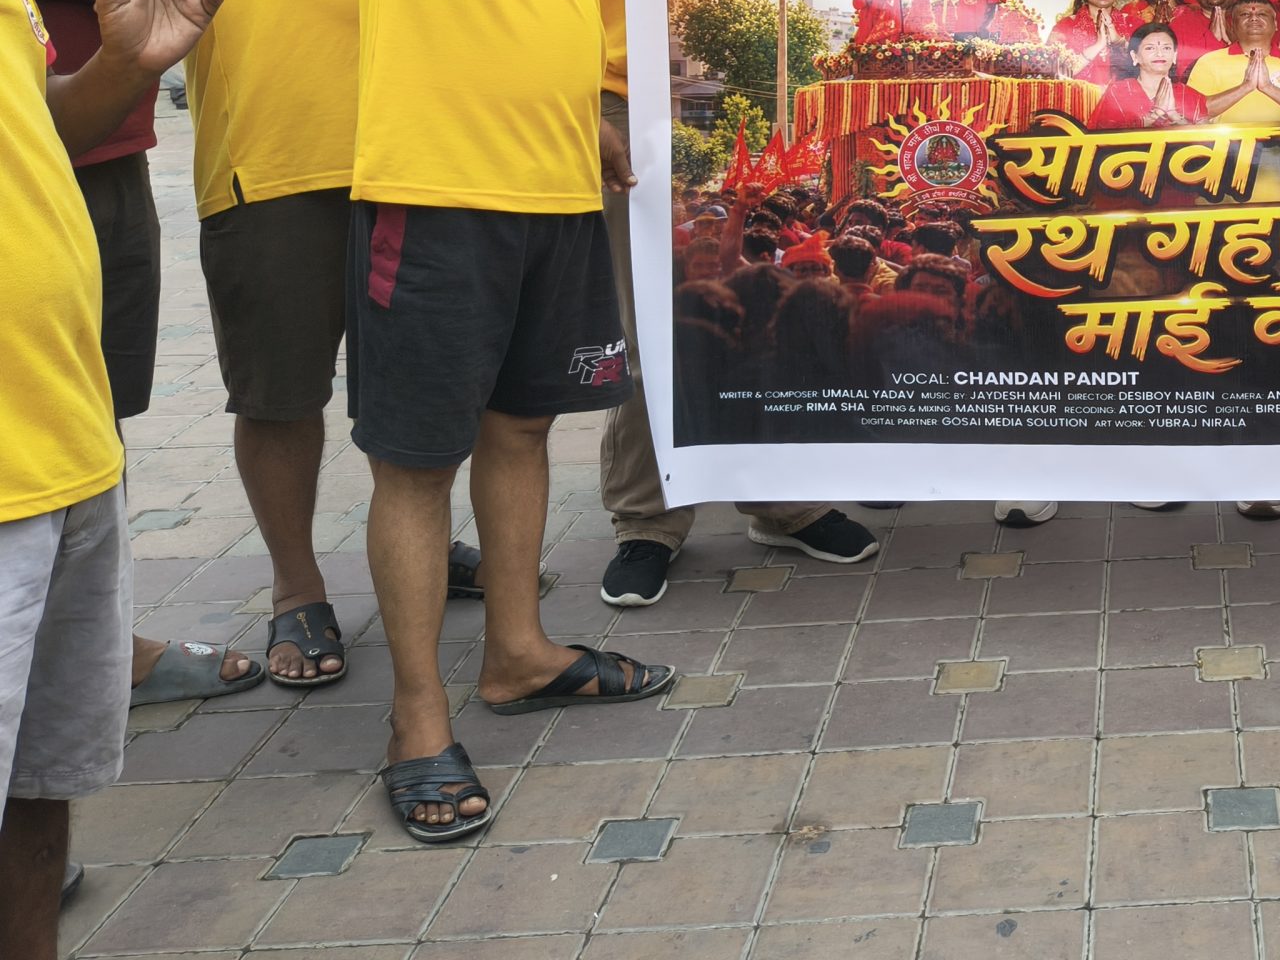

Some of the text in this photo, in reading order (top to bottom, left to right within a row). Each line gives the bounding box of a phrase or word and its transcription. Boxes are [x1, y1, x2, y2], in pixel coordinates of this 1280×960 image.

[970, 214, 1142, 298] रथ
[1056, 281, 1244, 374] माई
[891, 371, 1140, 386] VOCAL: CHANDAN PANDIT
[719, 391, 753, 399] WRITER
[755, 391, 762, 399] &
[822, 389, 870, 399] UMALAL
[872, 389, 915, 400] YADAV
[921, 391, 951, 400] MUSIC
[969, 390, 1026, 401] JAYDESH
[1029, 390, 1062, 401] MAHI
[1067, 392, 1117, 401] DIRECTOR:
[1118, 390, 1172, 401] DESIBOY
[1175, 390, 1216, 401] NABIN
[806, 402, 838, 412] RIMA
[840, 402, 866, 412] SHA
[871, 404, 907, 413] EDITING
[908, 404, 916, 413] &
[955, 403, 1005, 414] MANISH
[1008, 404, 1057, 414] THAKUR
[1118, 404, 1163, 415] ATOOT
[1166, 404, 1208, 414] MUSIC
[861, 417, 895, 426] DIGITAL
[941, 416, 982, 427] GOSAI
[984, 417, 1023, 427] MEDIA
[1026, 417, 1088, 428] SOLUTION
[1094, 419, 1112, 428] ART
[1148, 418, 1198, 428] YUBRAJ
[1201, 417, 1247, 428] NIRALA
